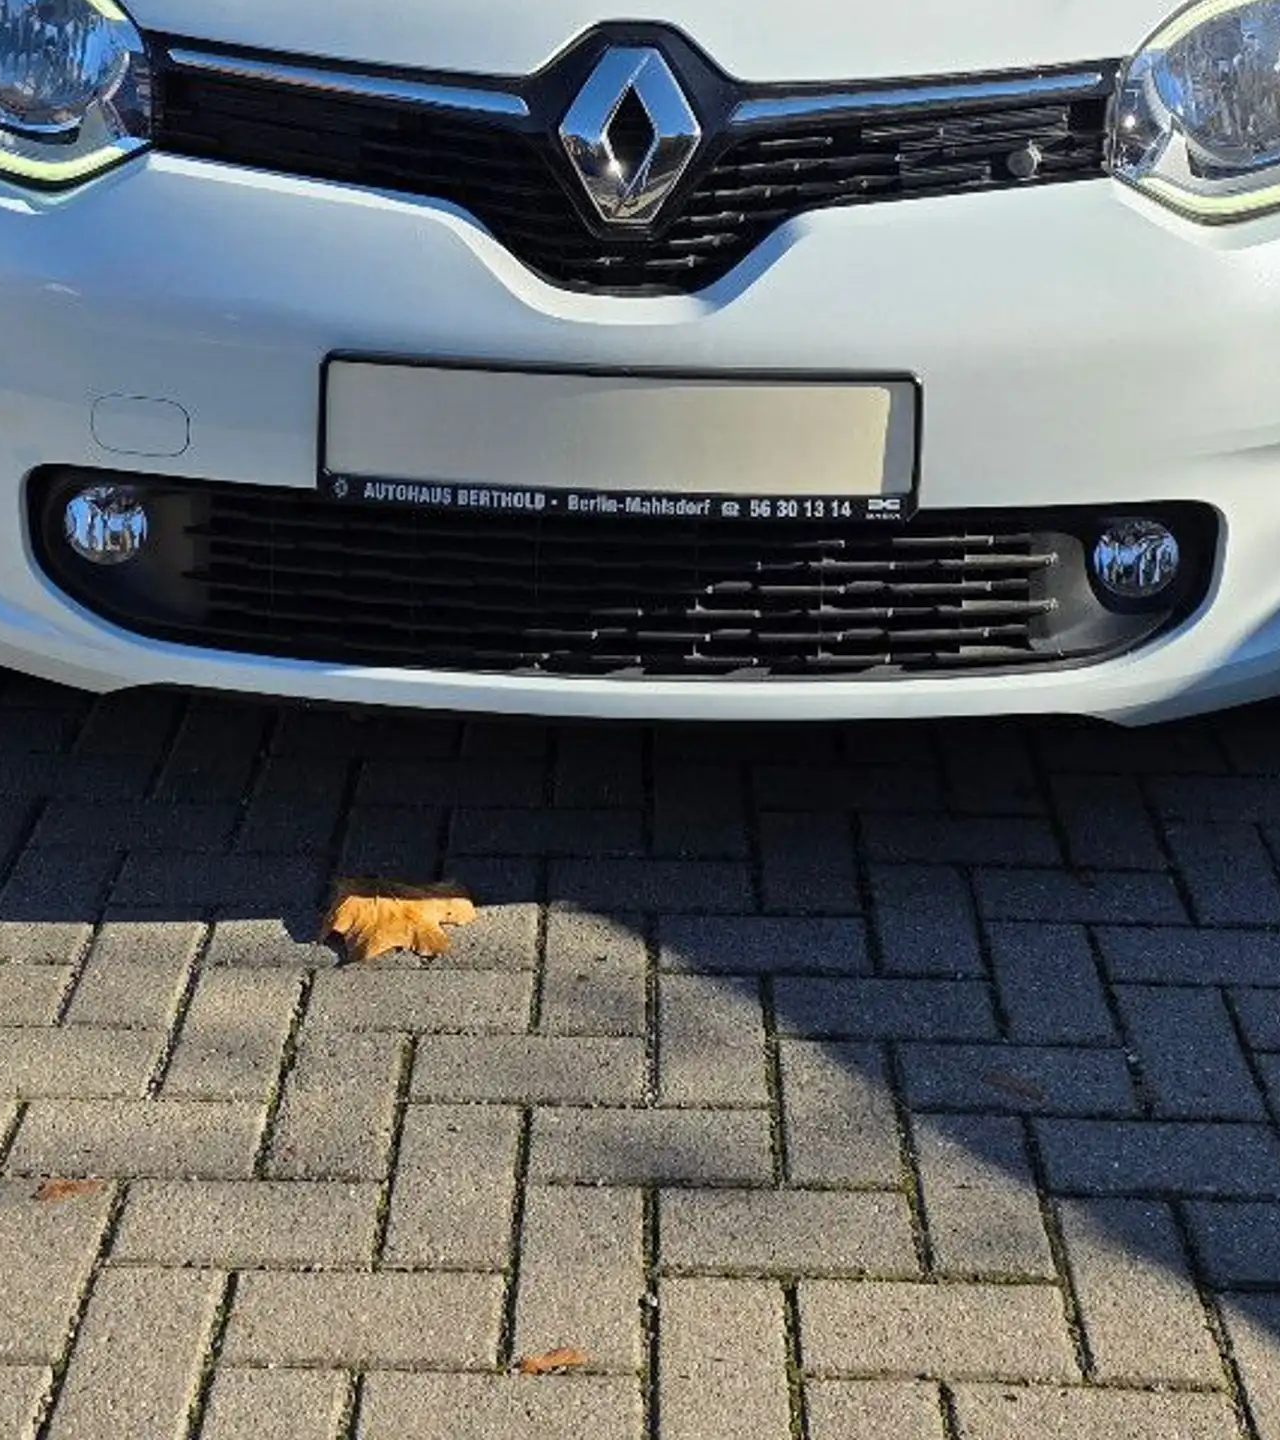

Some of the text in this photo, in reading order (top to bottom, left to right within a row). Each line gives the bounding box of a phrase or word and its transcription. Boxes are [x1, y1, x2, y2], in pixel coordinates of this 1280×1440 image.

[364, 481, 451, 505] AUTOHAUS
[457, 490, 545, 511] BERTHOLD
[567, 494, 710, 516] Berlin-Mahlsdorf
[749, 500, 770, 517] 56
[776, 500, 797, 517] 30
[803, 500, 824, 518] 13
[831, 500, 852, 518] 14
